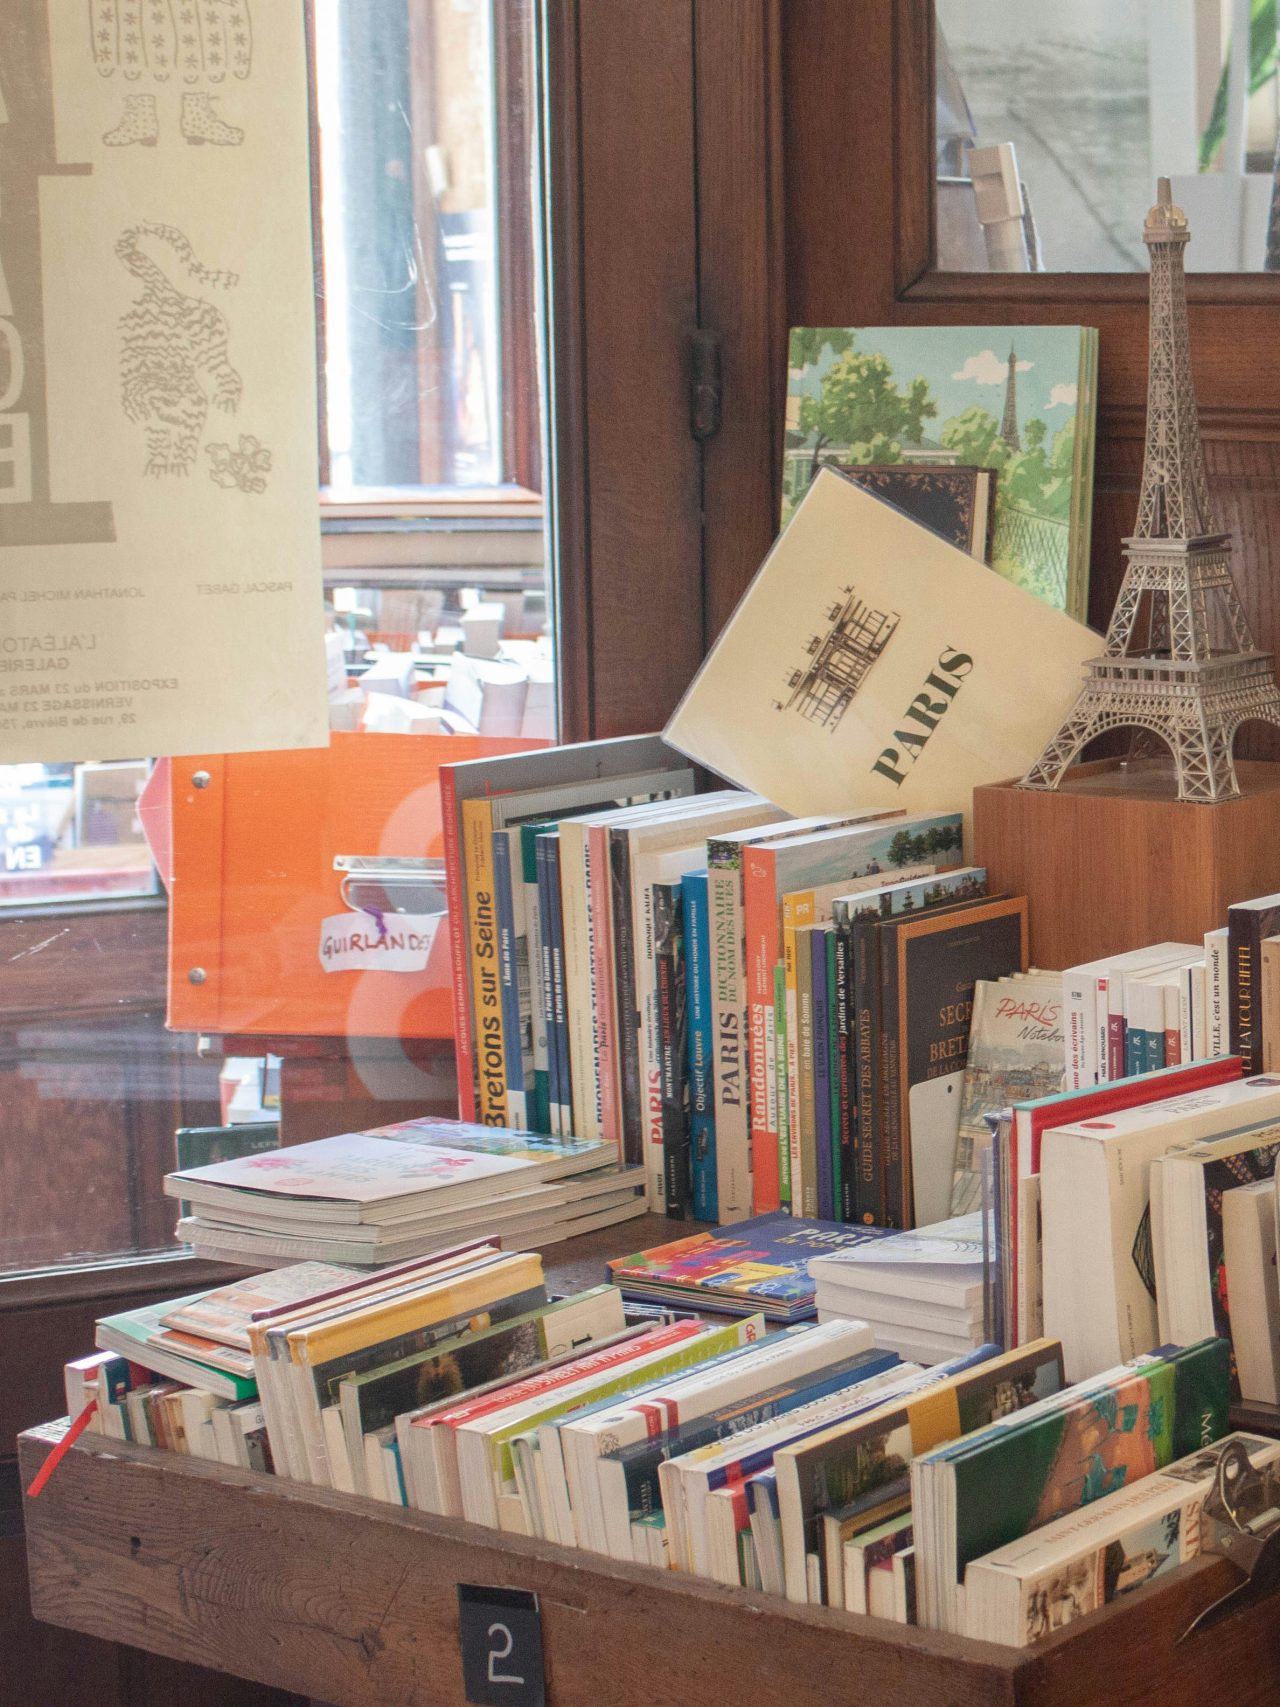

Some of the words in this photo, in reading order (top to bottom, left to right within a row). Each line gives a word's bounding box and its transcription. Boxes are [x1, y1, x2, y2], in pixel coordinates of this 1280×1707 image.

[869, 645, 976, 790] PARIS
[473, 891, 494, 959] Seine
[501, 928, 510, 950] Paris
[714, 878, 728, 1003] DICTIONNAIRE
[726, 919, 736, 945] DES
[542, 945, 551, 981] Casanova
[552, 948, 562, 984] Casanova
[727, 946, 737, 981] NOM
[835, 941, 846, 986] Versailles
[478, 971, 497, 1008] sur
[544, 982, 552, 992] de
[544, 993, 553, 1012] Paris
[554, 985, 562, 994] de
[693, 974, 701, 1005] HISTOIRE
[837, 987, 846, 1000] de
[1213, 984, 1220, 997] un
[545, 1012, 553, 1021] Le
[554, 995, 563, 1014] Paris
[556, 1014, 564, 1023] Le
[800, 992, 810, 1024] Somme
[837, 1001, 849, 1035] Jardins
[995, 998, 1063, 1027] PARIS
[1212, 1000, 1220, 1021] c'est
[1238, 988, 1252, 1027] TOUR
[766, 1010, 774, 1042] Paris
[801, 1025, 810, 1037] de
[859, 1008, 871, 1062] ABBAYES
[1070, 1011, 1078, 1052] écrivains
[1213, 1023, 1222, 1056] VILLE,
[694, 1030, 704, 1067] Louvre
[717, 1011, 741, 1107] PARIS
[776, 1033, 785, 1064] SEINE
[801, 1038, 811, 1058] baie
[1071, 1054, 1079, 1069] des
[663, 1045, 674, 1099] MONTMARTRE
[750, 1003, 767, 1133] Randonnées
[861, 1064, 872, 1088] DES
[694, 1070, 705, 1111] Objectif
[648, 1070, 665, 1146] PARIS
[862, 1092, 873, 1138] SECRET
[862, 1139, 874, 1182] GUIDE
[487, 1622, 524, 1687] 2
